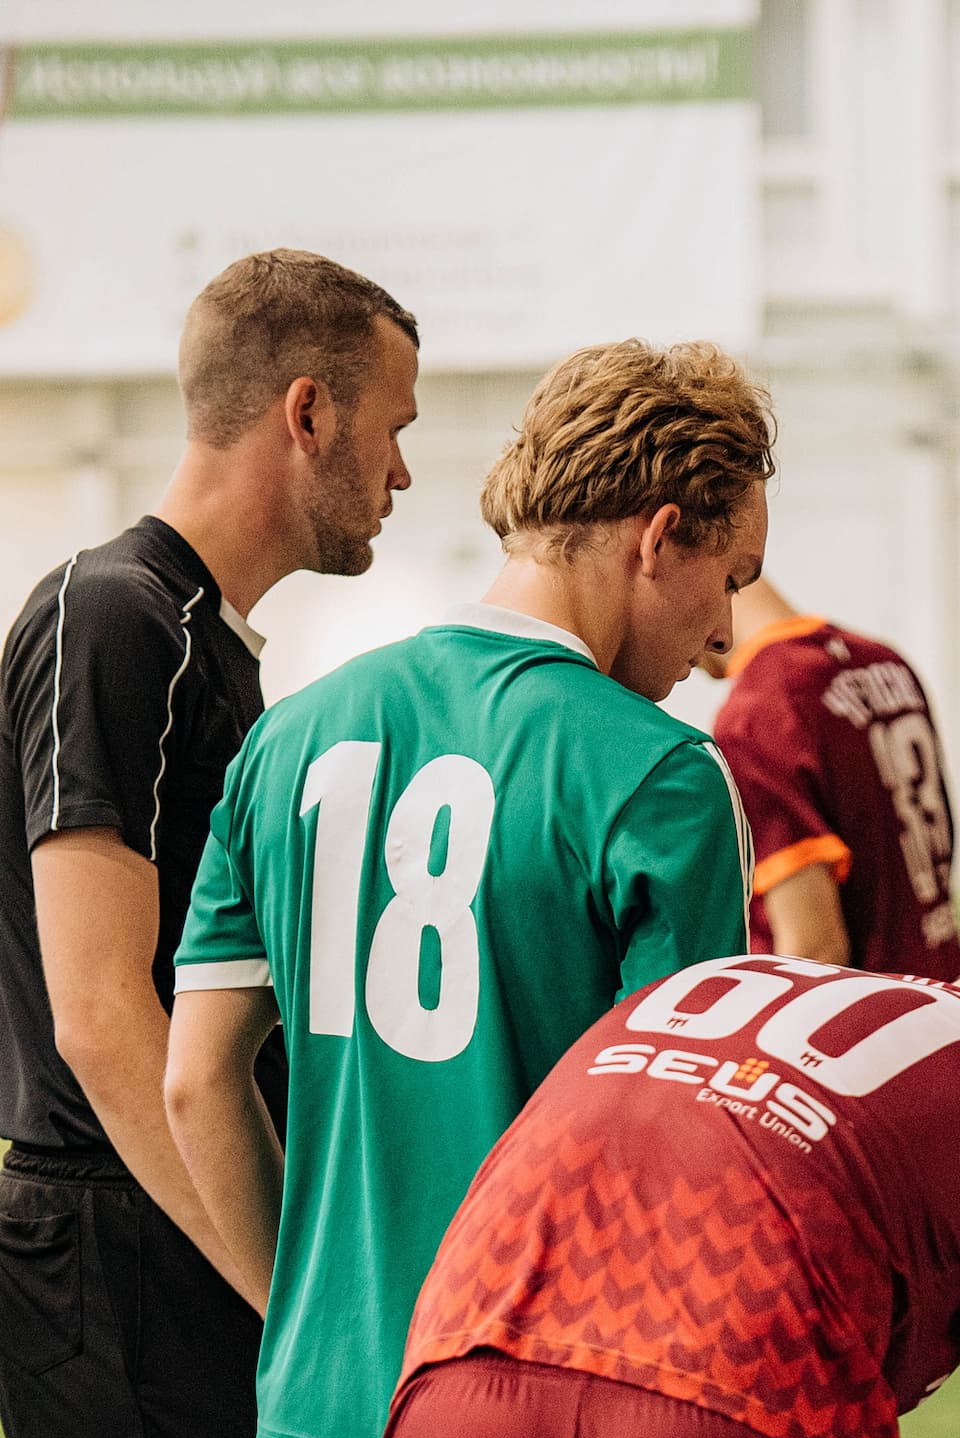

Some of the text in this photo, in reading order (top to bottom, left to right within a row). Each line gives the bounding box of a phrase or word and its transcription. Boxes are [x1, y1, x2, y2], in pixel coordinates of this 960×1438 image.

[299, 740, 496, 1062] 18
[587, 1043, 837, 1142] SEUS
[695, 1087, 812, 1154] Export Union
